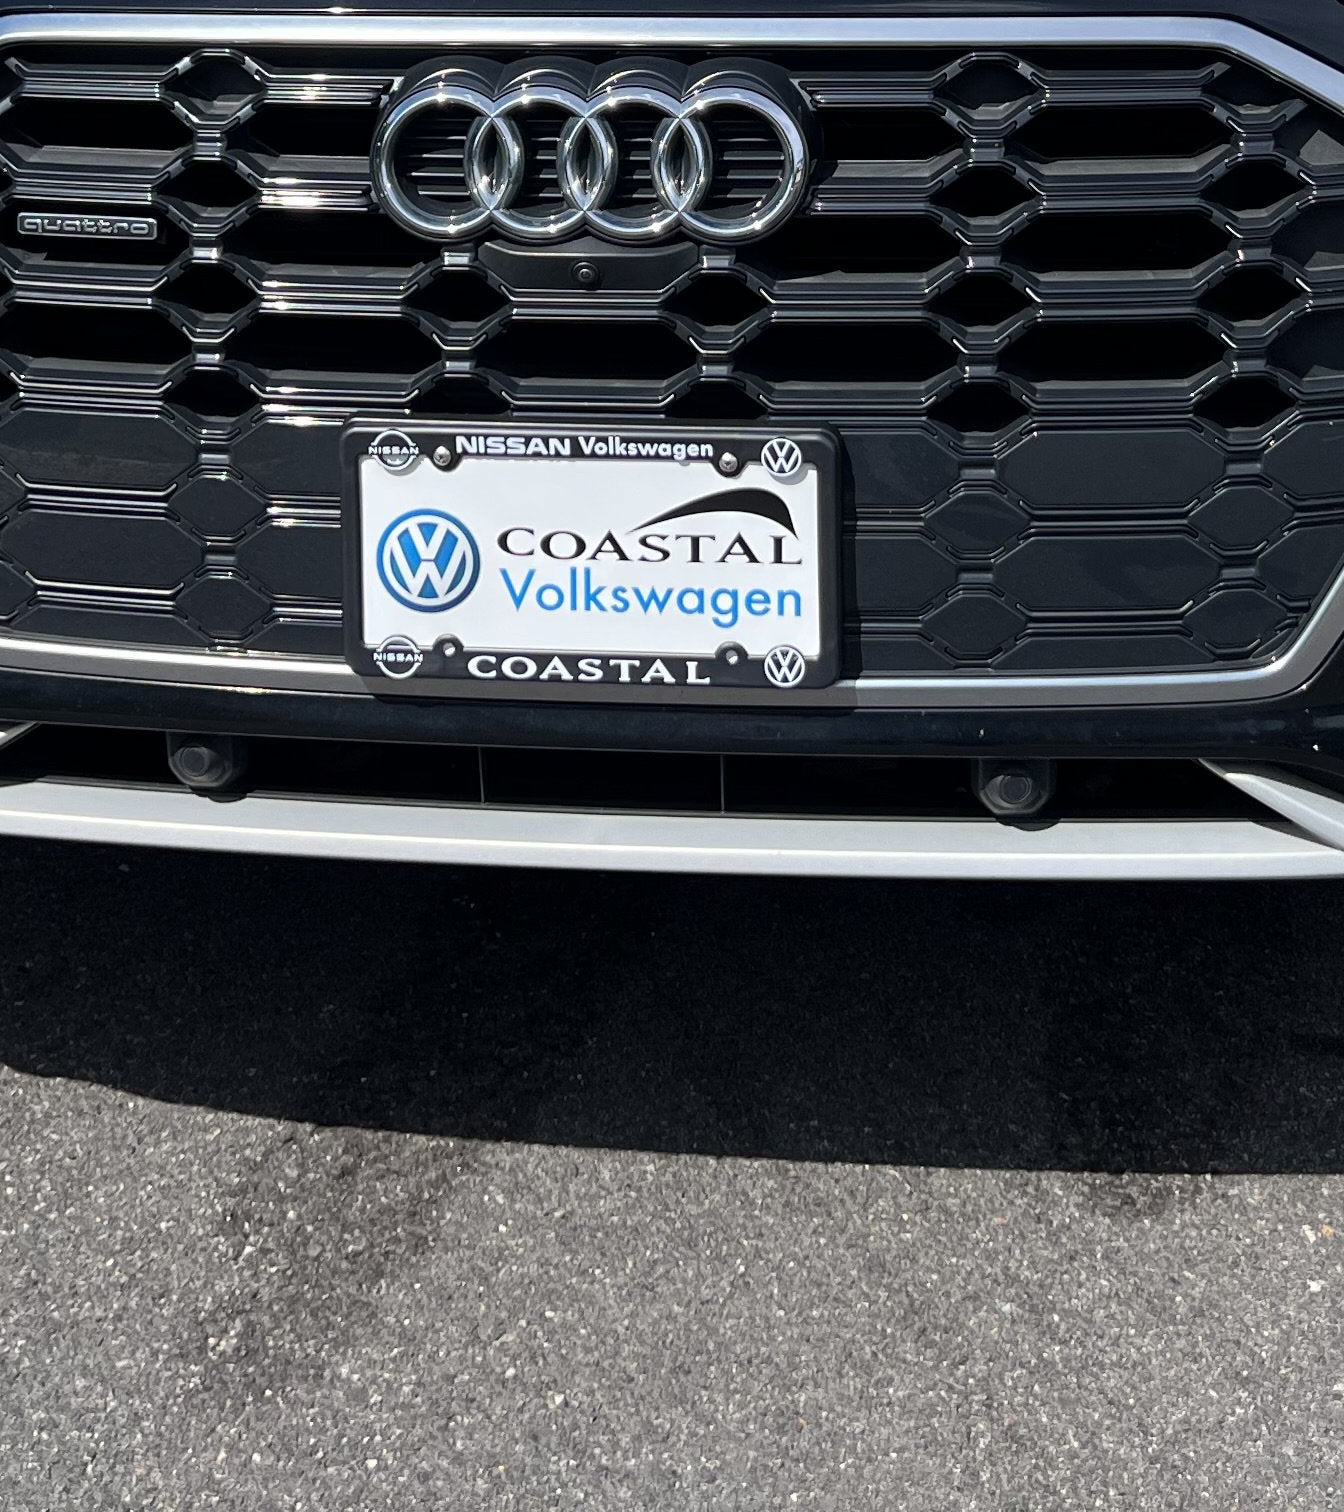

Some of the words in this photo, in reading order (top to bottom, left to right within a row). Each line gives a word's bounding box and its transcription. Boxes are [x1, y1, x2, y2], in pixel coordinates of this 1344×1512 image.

[23, 219, 149, 234] quattro
[368, 445, 419, 456] NISSAN
[455, 434, 571, 456] NISSAN
[577, 435, 714, 460] Volkswagen
[496, 527, 803, 565] COASTAL
[499, 567, 803, 628] Volkswagen
[373, 652, 424, 663] NISSAN
[467, 655, 712, 685] COASTAL
